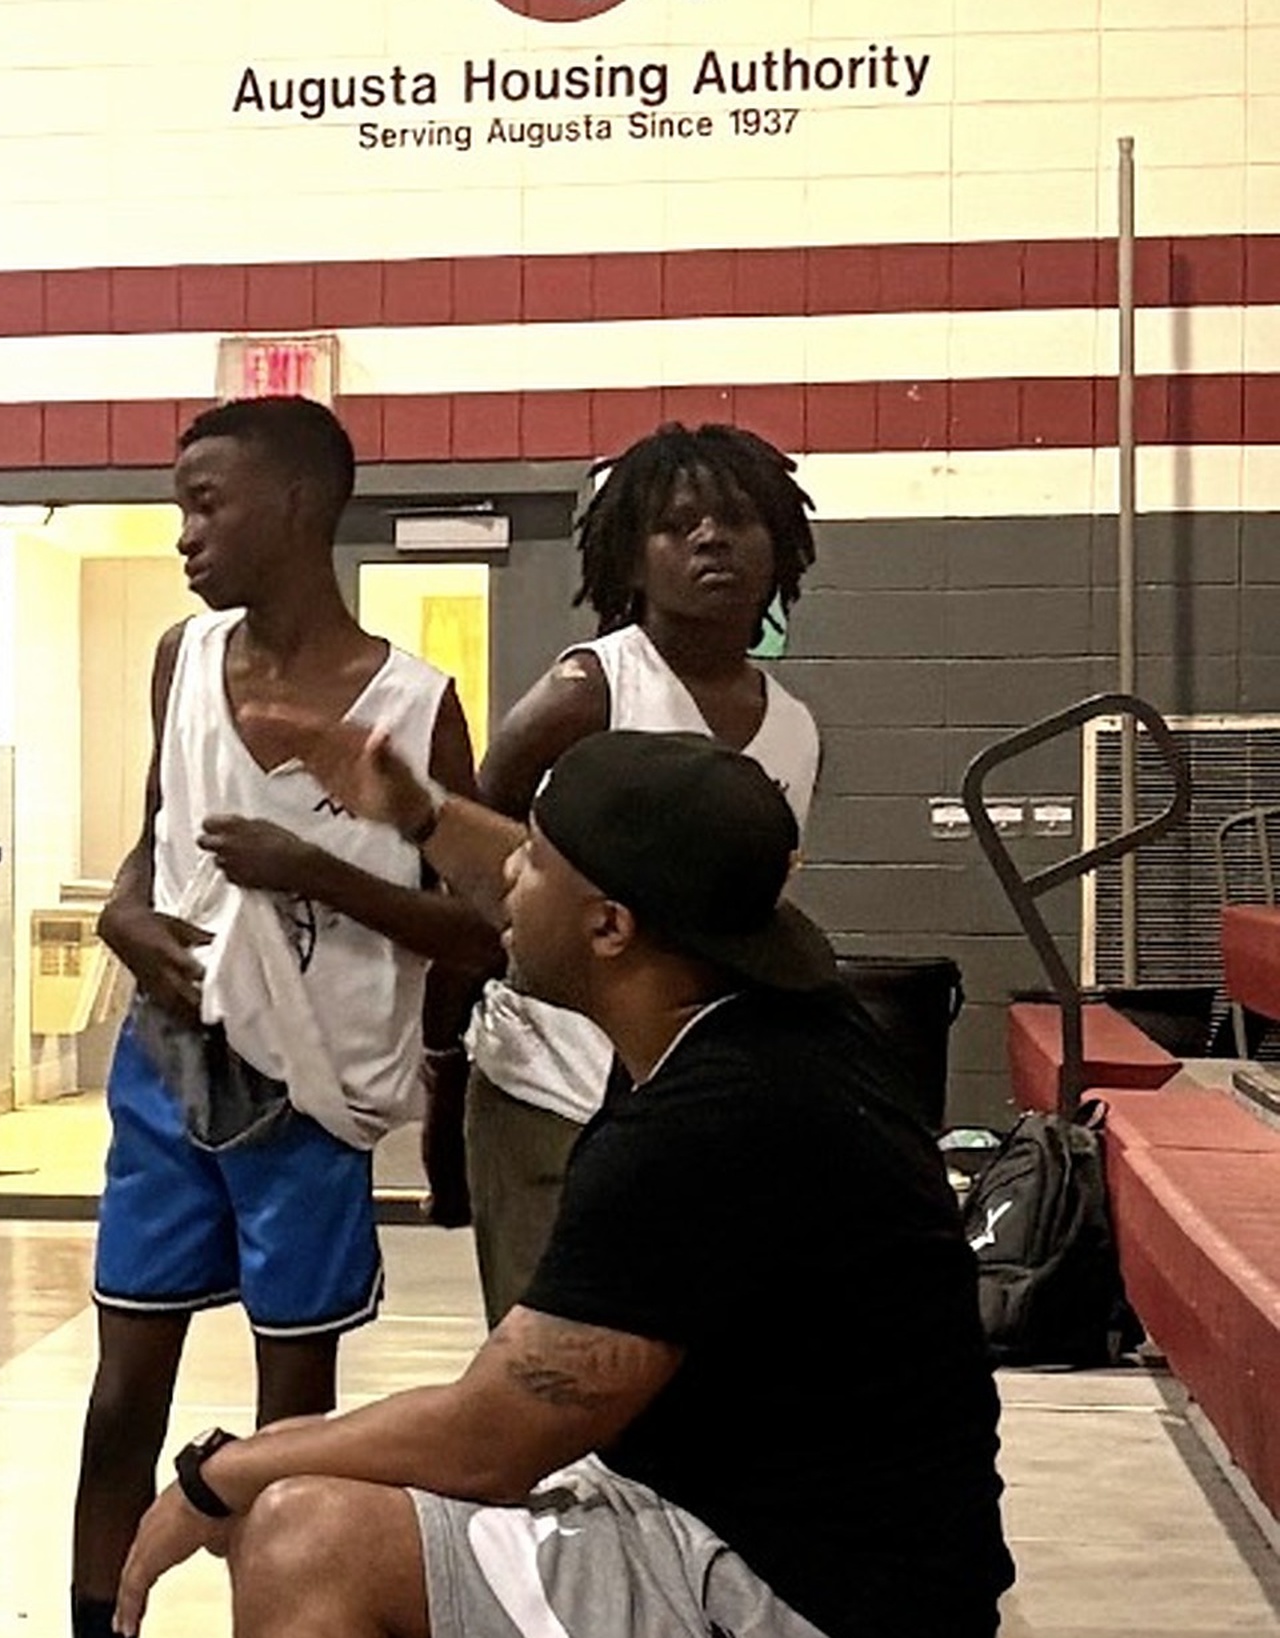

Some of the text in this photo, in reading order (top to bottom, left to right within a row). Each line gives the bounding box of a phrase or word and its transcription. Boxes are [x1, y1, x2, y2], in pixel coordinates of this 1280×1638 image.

[232, 43, 931, 119] Augusta Housing Authority
[358, 107, 801, 151] Serving Augusta Since 1937
